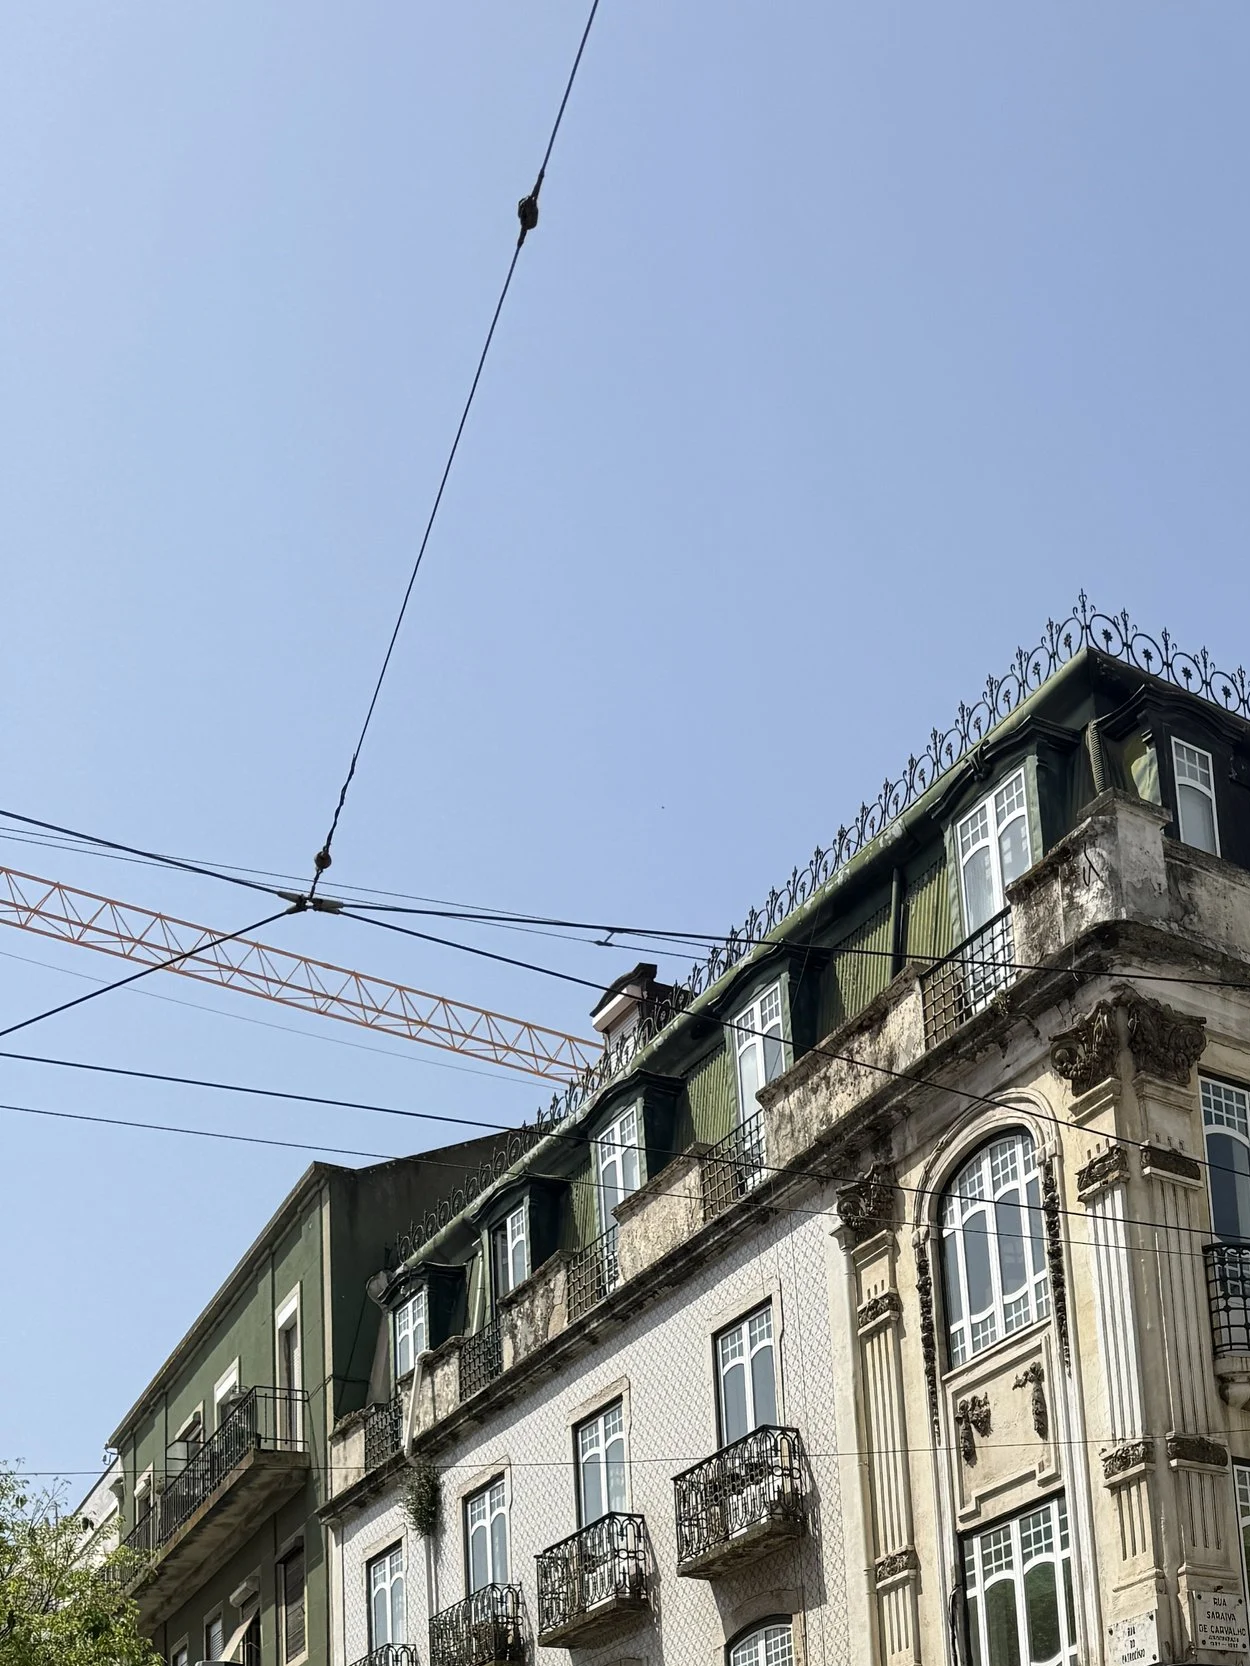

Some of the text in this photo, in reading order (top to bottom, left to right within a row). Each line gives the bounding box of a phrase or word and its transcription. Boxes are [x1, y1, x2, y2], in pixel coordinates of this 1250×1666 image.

[1213, 1597, 1227, 1607] RUA
[1206, 1610, 1237, 1621] SARAIVA
[1198, 1623, 1247, 1637] DE CARVALHO
